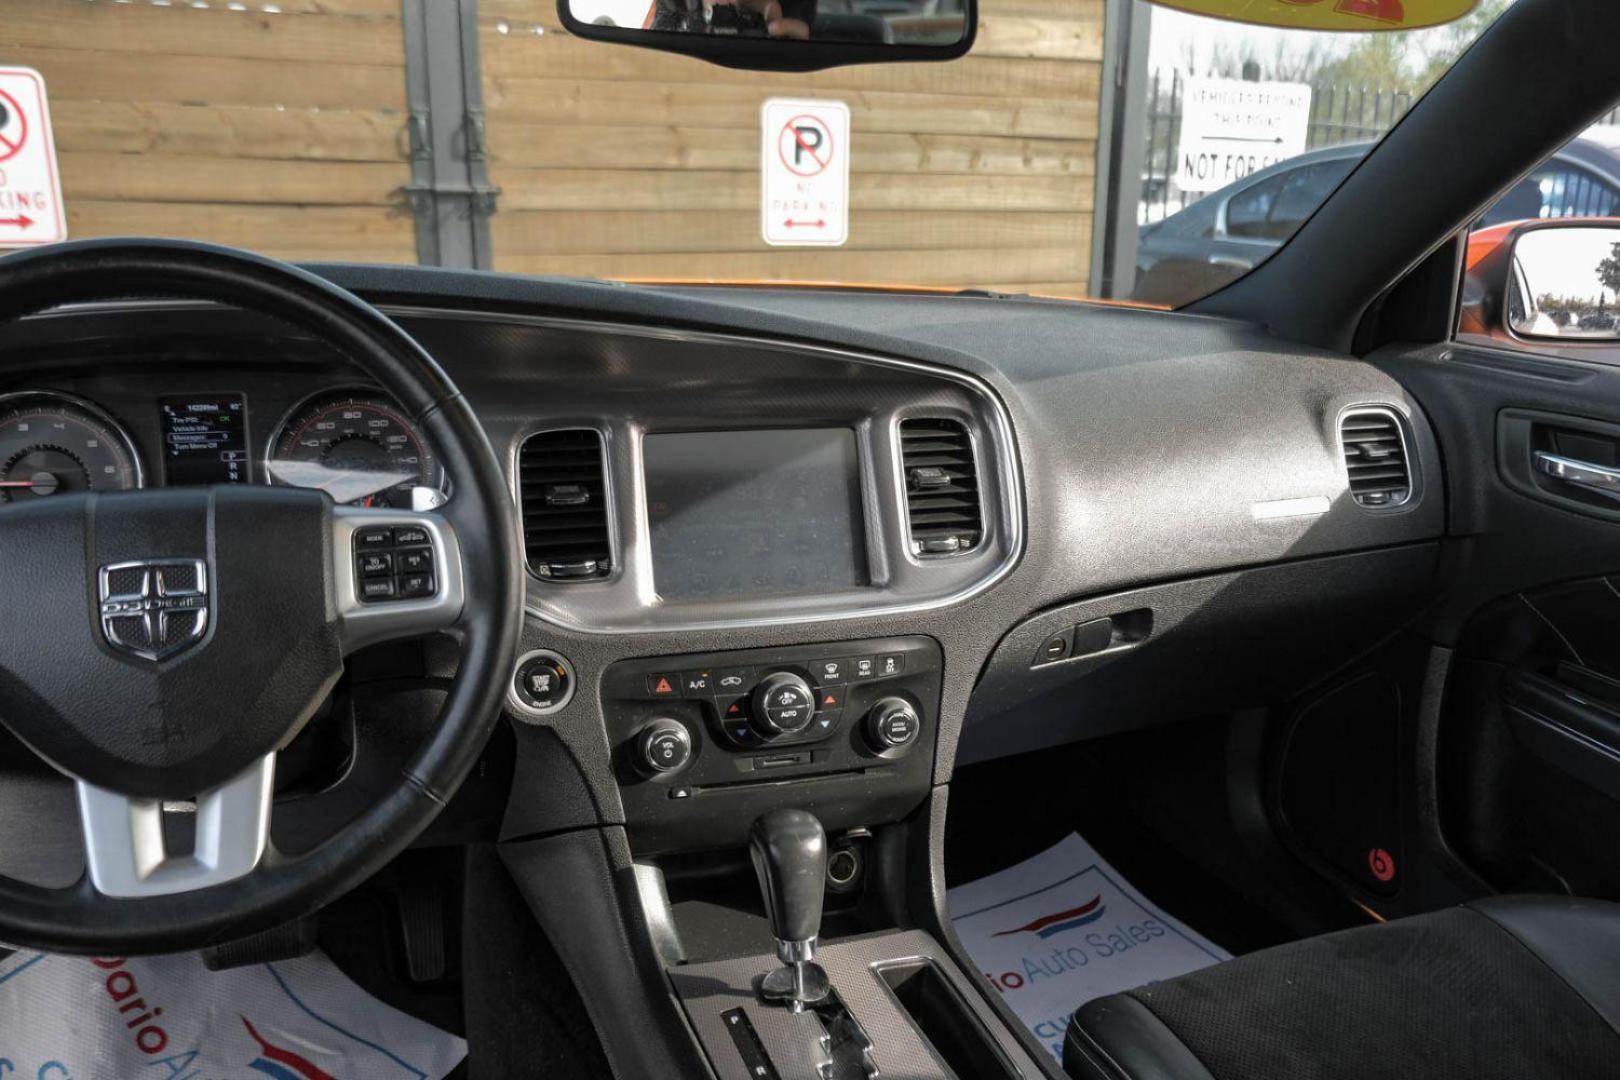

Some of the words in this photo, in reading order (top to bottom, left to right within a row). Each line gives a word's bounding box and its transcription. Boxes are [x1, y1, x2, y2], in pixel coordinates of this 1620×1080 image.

[1184, 152, 1219, 180] NOT
[1225, 153, 1256, 181] FOR
[689, 680, 705, 689] A/C
[780, 710, 798, 718] AUTO
[1085, 919, 1166, 958] Sales
